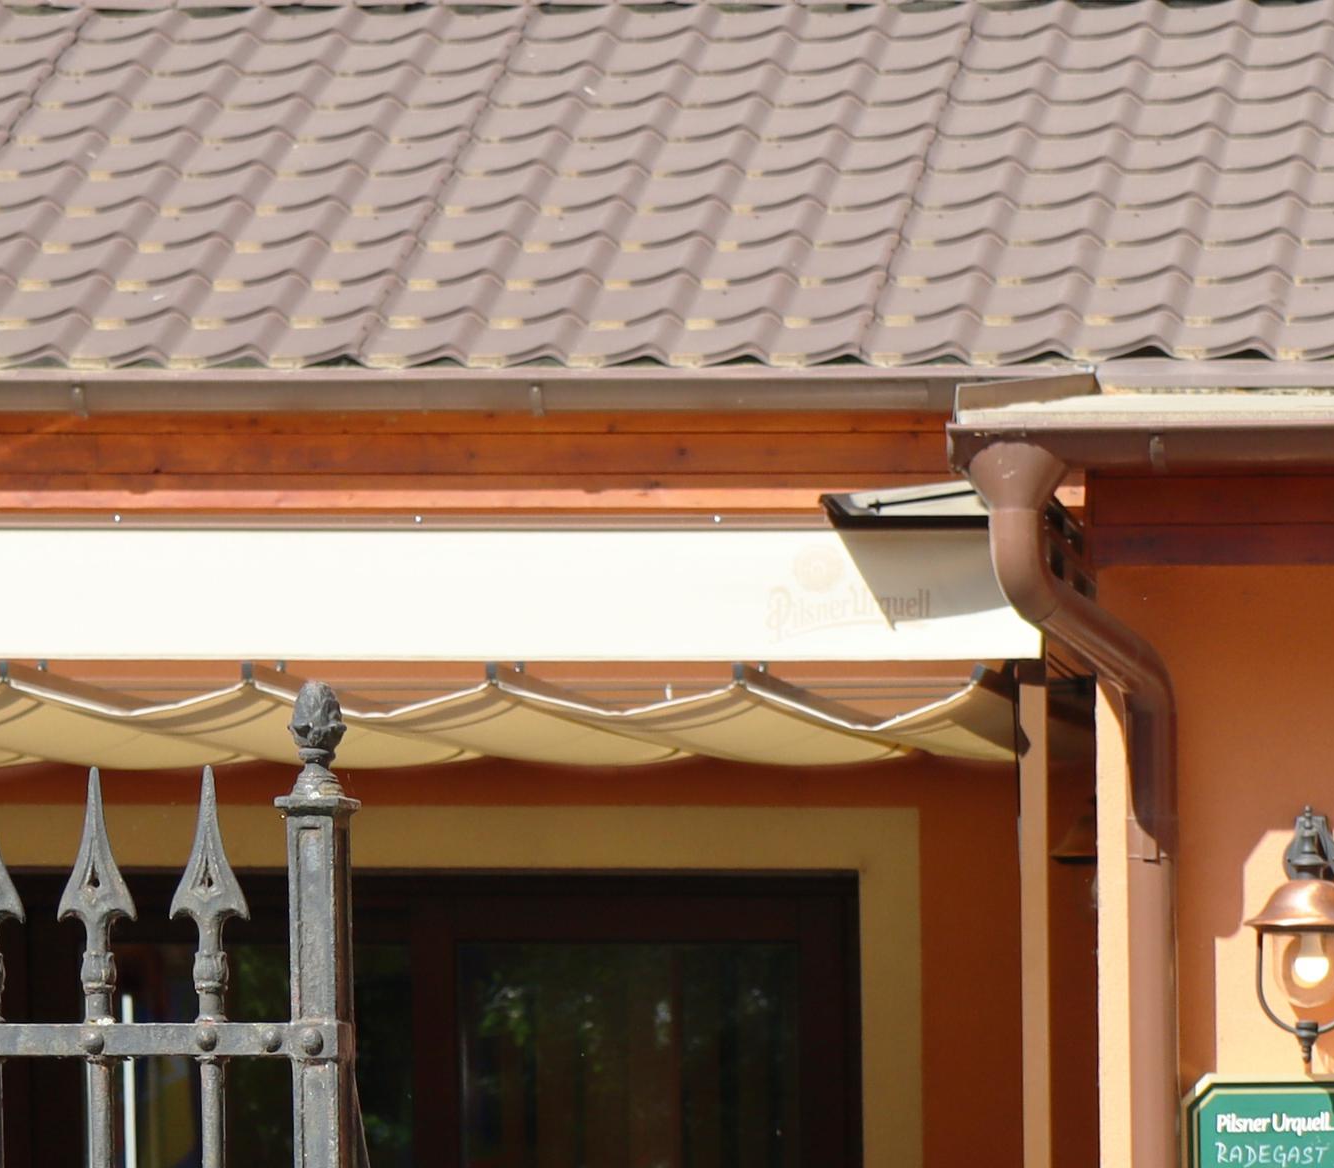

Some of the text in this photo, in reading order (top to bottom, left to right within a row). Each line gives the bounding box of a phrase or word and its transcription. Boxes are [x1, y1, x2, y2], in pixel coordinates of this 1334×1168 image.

[765, 584, 931, 645] Pilsner Urquell
[1216, 1112, 1269, 1134] Pilsner
[1271, 1110, 1332, 1137] Urquell
[1215, 1142, 1330, 1168] RADEGAST
